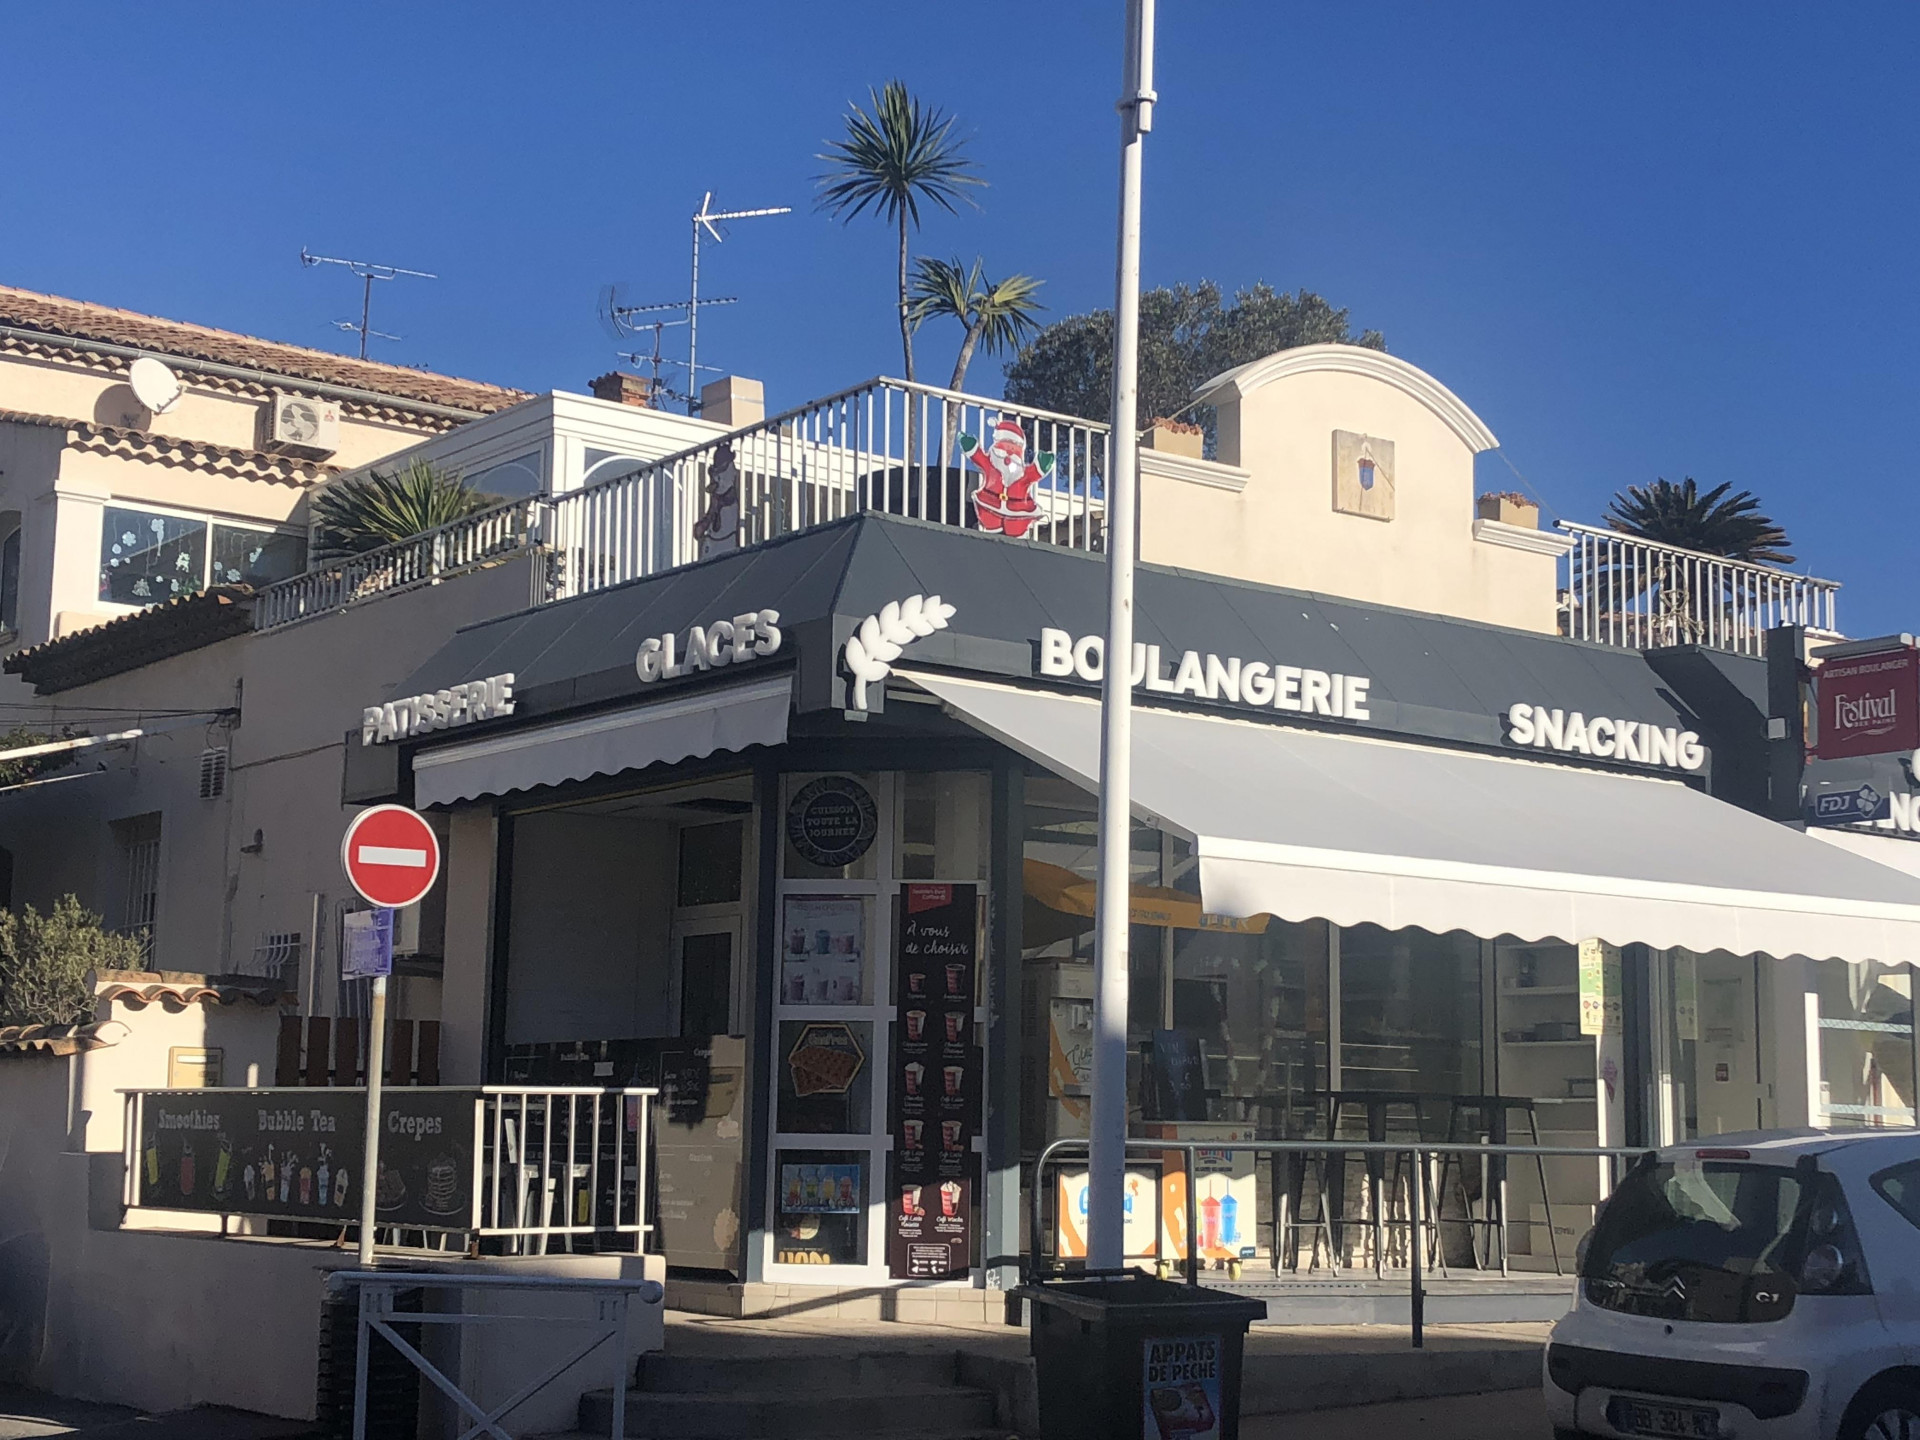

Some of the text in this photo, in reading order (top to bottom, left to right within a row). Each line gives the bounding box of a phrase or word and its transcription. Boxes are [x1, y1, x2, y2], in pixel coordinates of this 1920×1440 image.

[635, 608, 782, 683] GLACES
[1823, 658, 1909, 679] ARTISAN BOULANGER
[363, 671, 516, 747] PATISSERIE
[1834, 688, 1897, 730] Festival
[1508, 702, 1706, 771] SNACKING
[810, 805, 854, 814] CUISSON
[1819, 795, 1851, 812] FDJ
[806, 816, 859, 826] TOUTE LA
[906, 919, 951, 938] À vous
[905, 940, 969, 956] de choisir
[158, 1109, 221, 1130] Smoothies
[258, 1109, 336, 1133] Bubble Tea
[387, 1110, 443, 1142] Crepes
[1754, 1290, 1780, 1304] C1
[1149, 1340, 1216, 1364] APPATS
[1148, 1362, 1216, 1382] DE PECHE
